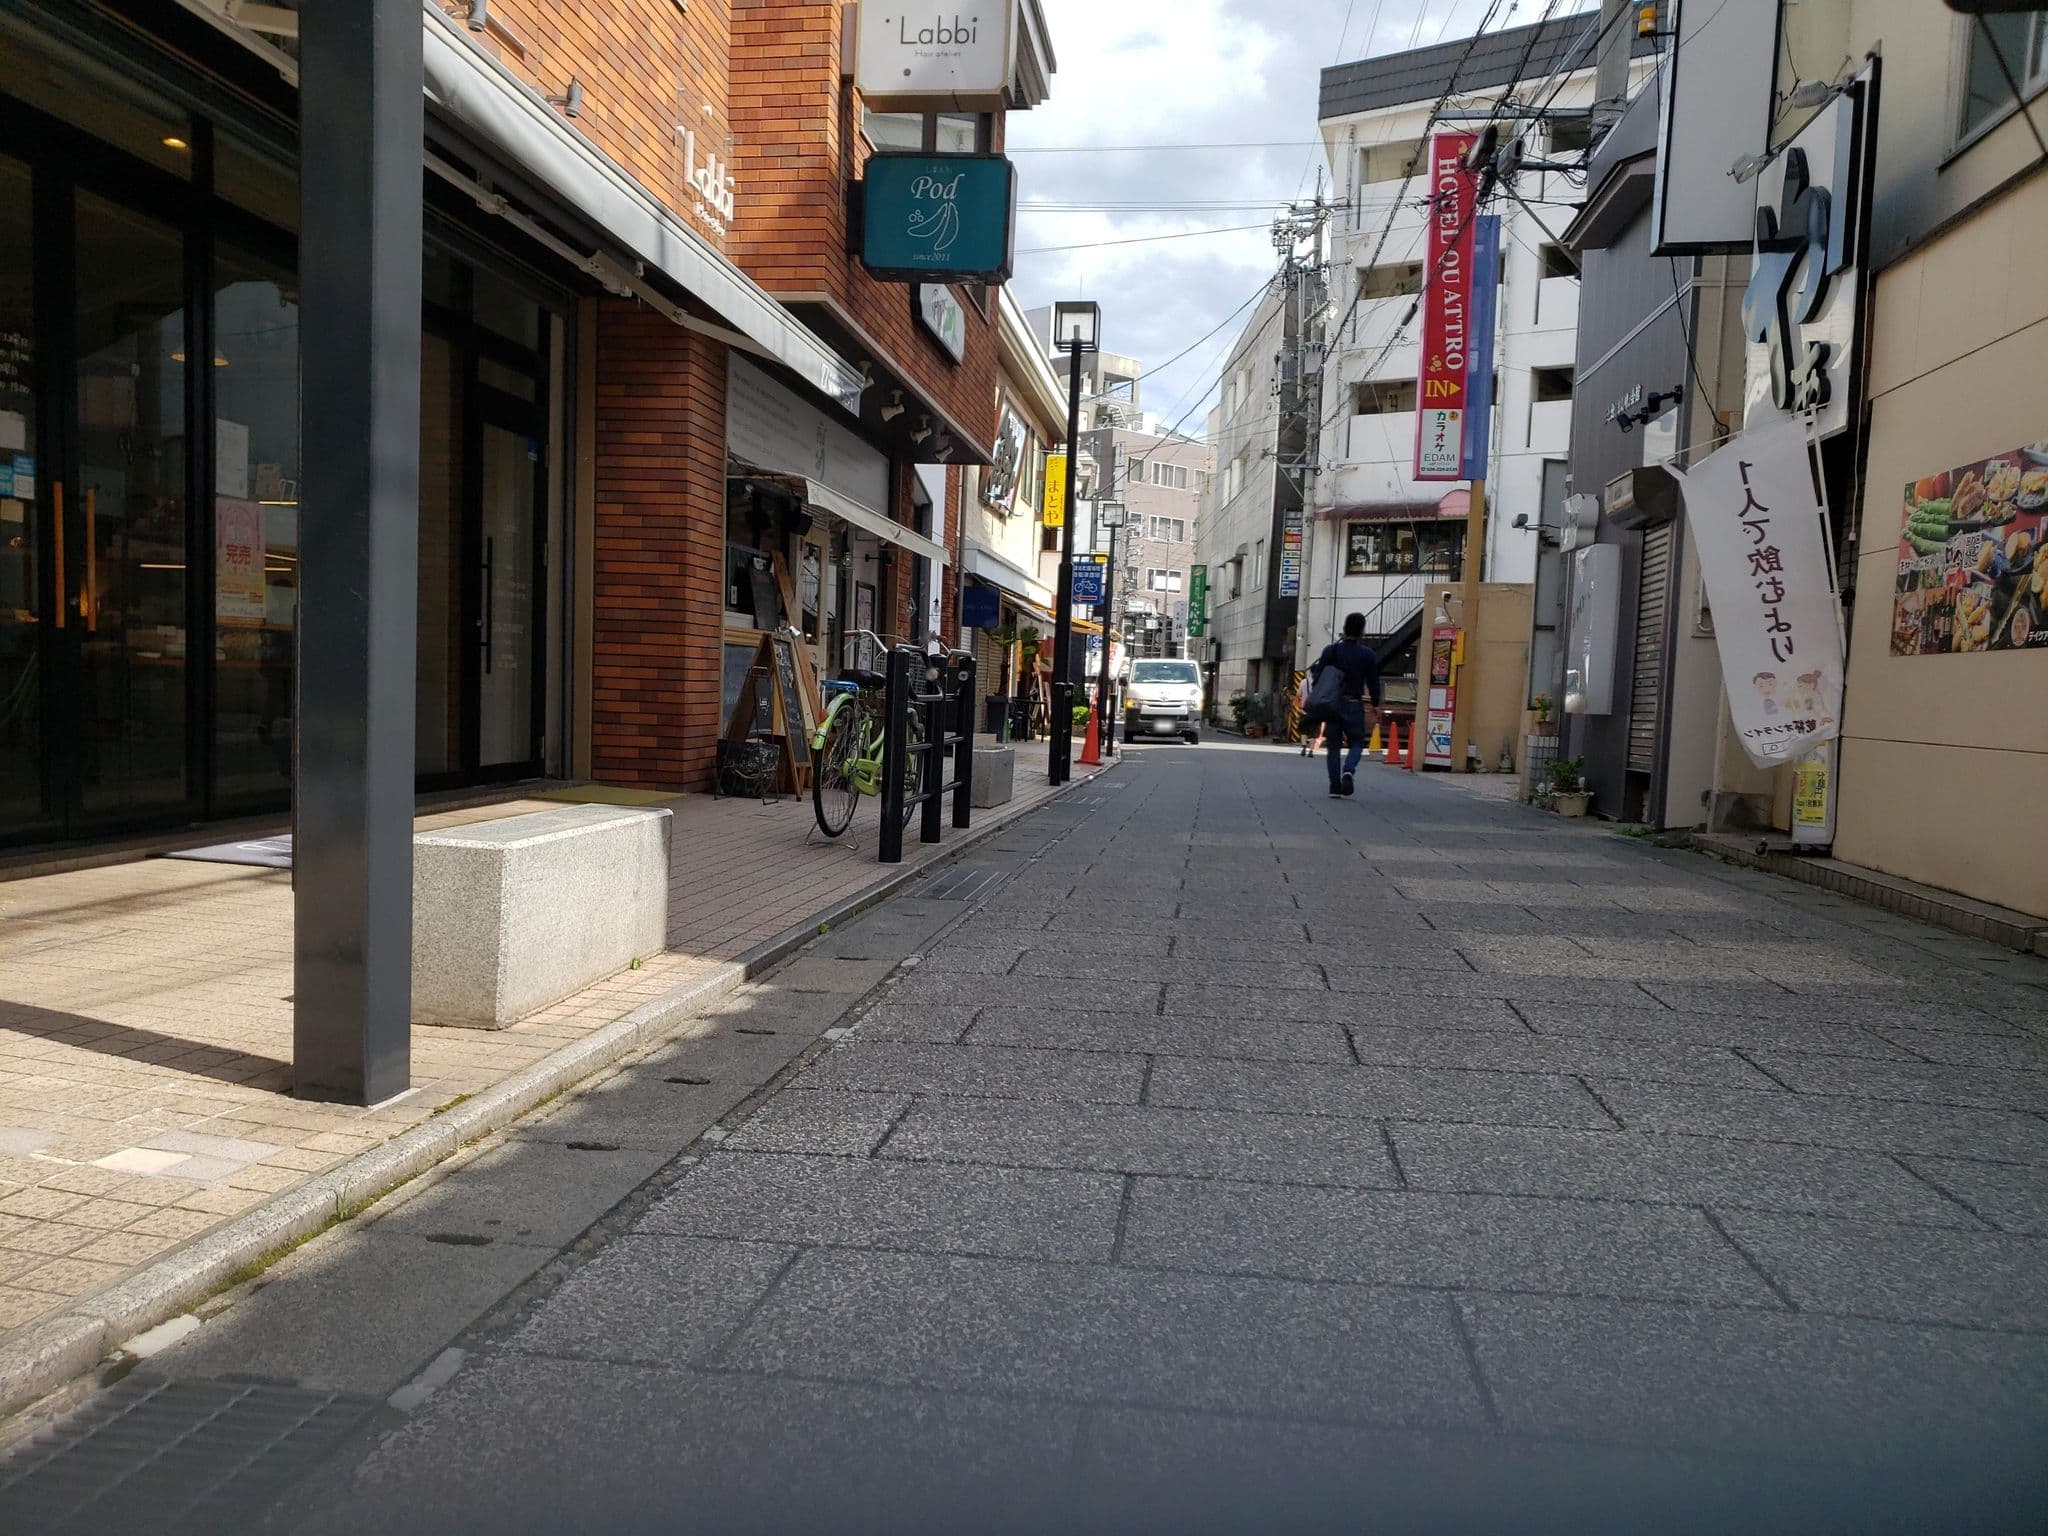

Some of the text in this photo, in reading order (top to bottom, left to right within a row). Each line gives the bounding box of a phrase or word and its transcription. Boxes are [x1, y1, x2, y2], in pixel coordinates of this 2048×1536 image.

[900, 15, 978, 44] Labbi
[684, 130, 734, 222] Labbi
[911, 173, 965, 200] Pod
[1438, 157, 1460, 245] HOTEL
[1425, 380, 1449, 398] IN
[1435, 411, 1447, 452] カラオケ
[1424, 453, 1456, 462] EDAM
[1047, 480, 1060, 524] まとや
